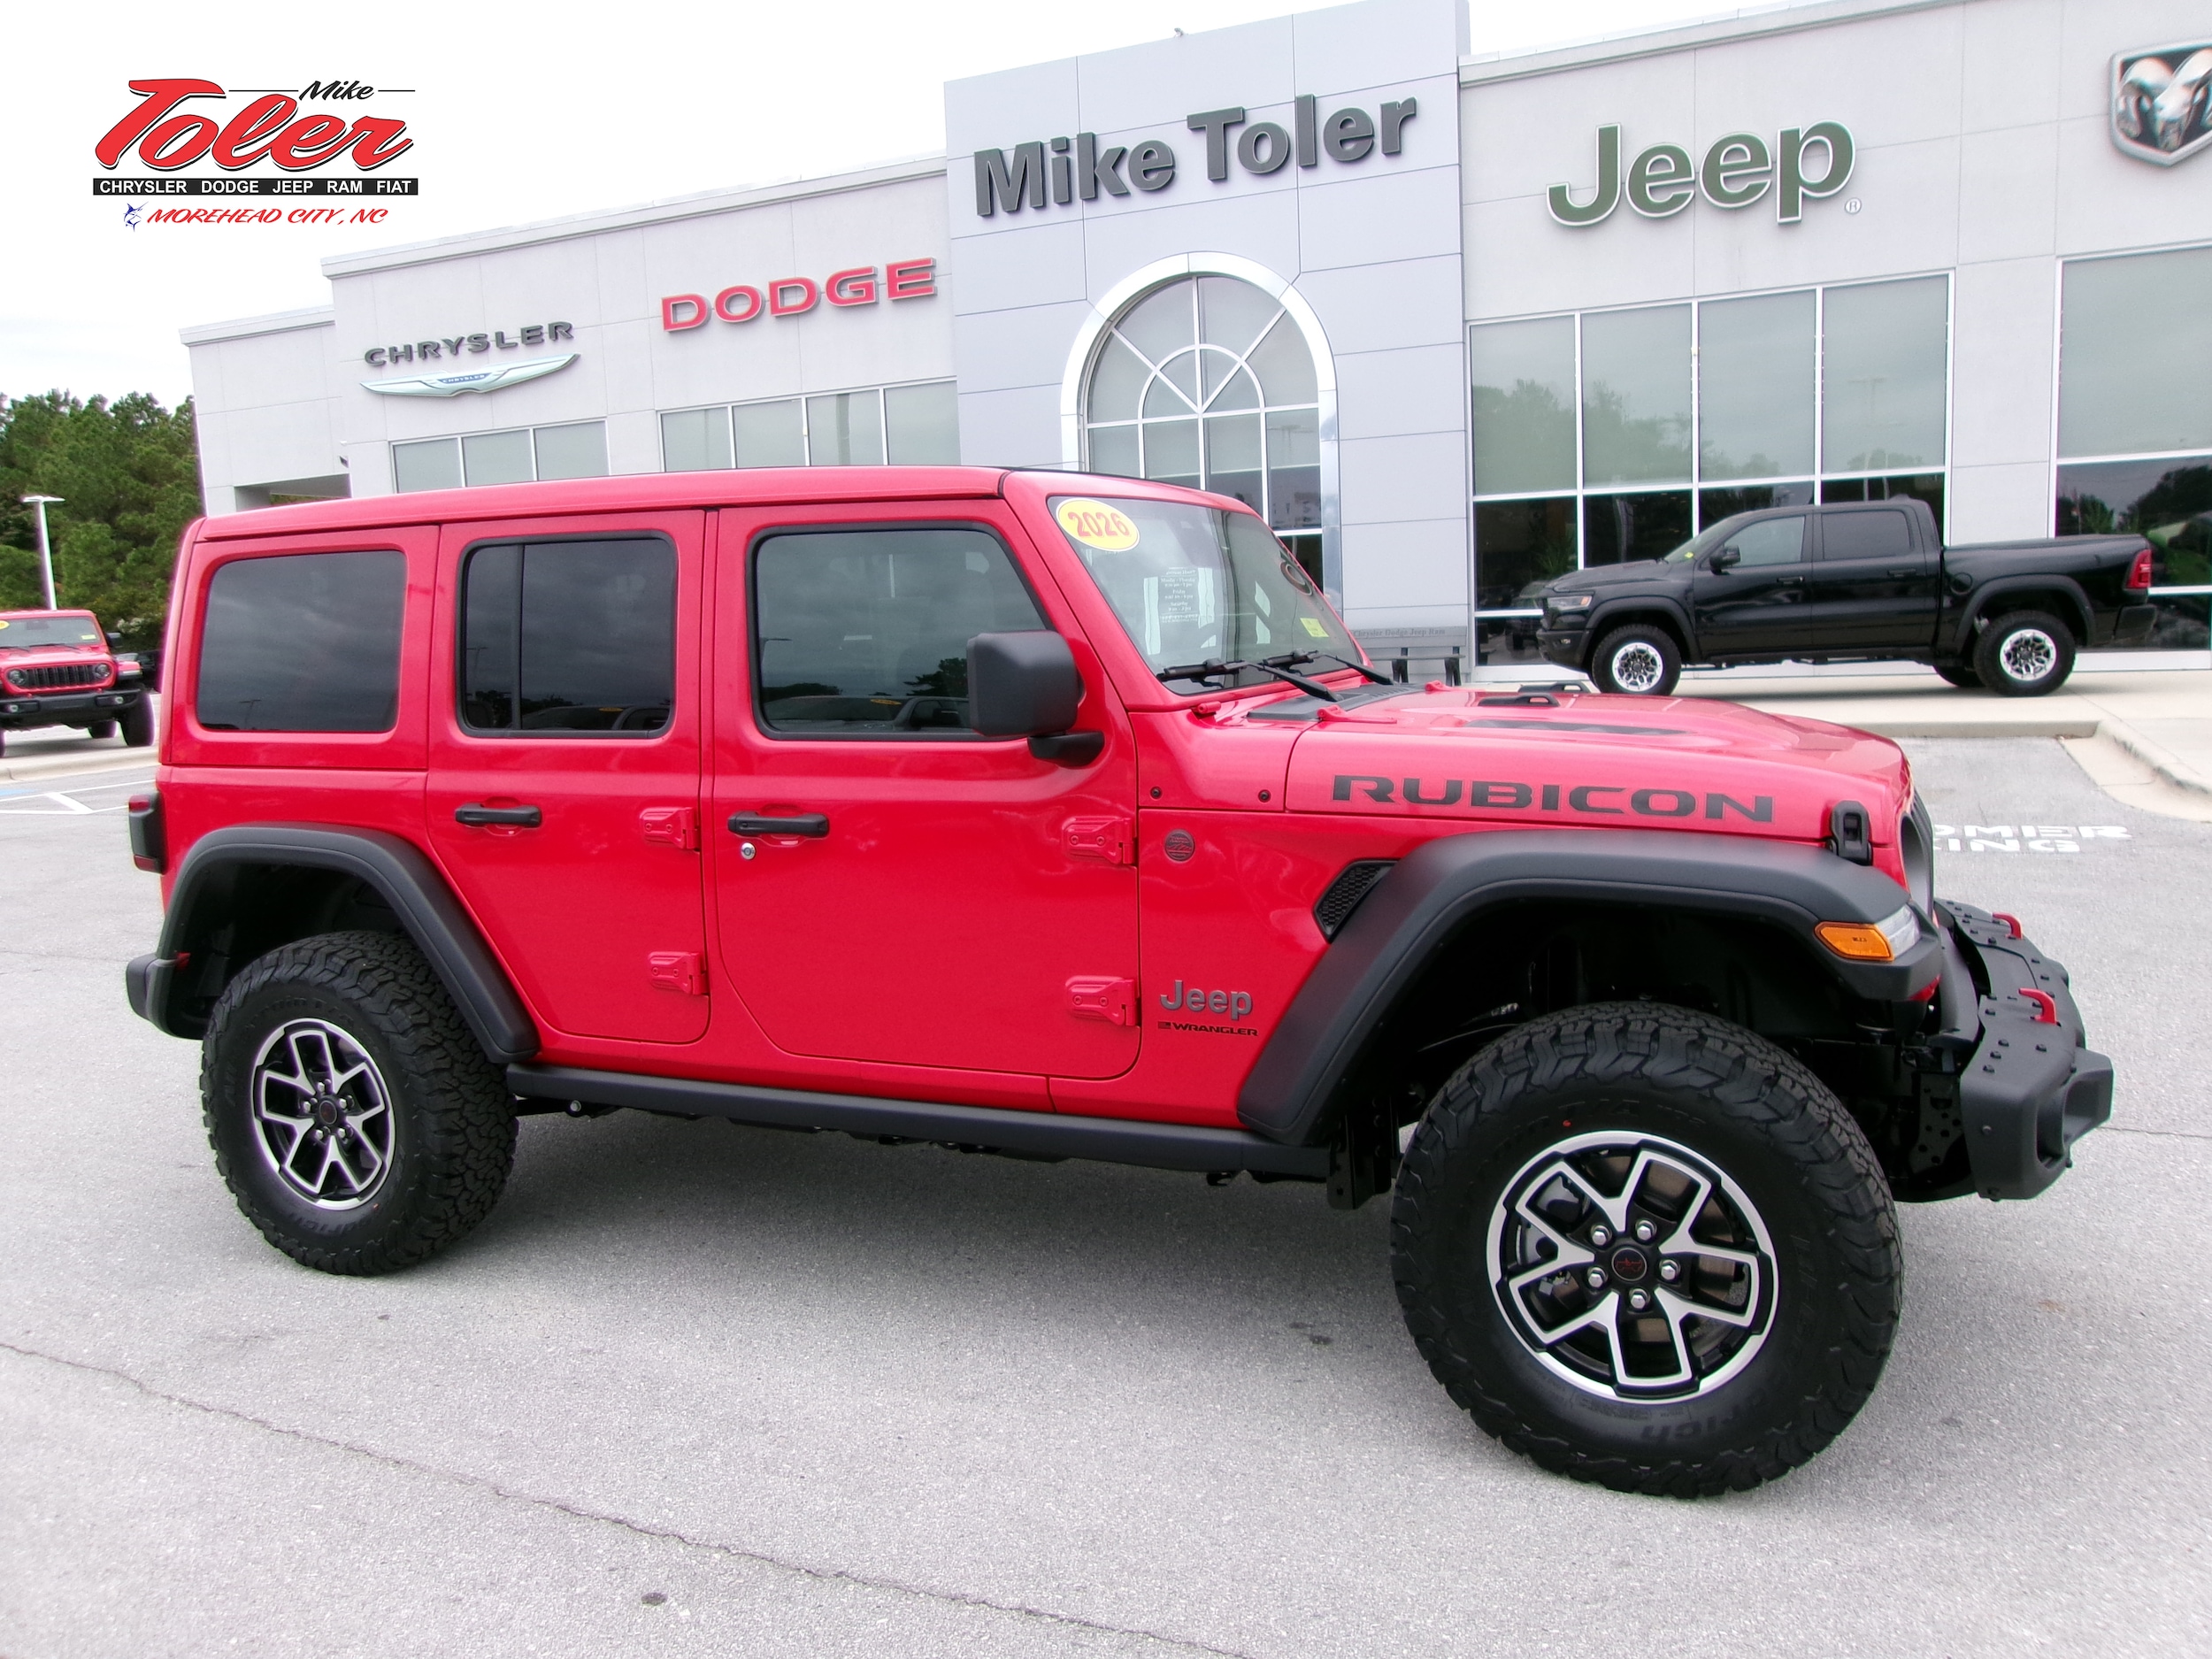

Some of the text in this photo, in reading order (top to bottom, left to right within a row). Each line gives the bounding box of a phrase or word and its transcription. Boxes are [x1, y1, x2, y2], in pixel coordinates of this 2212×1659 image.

[974, 93, 1417, 217] Mike Toler
[1546, 120, 1857, 226] Jeep
[660, 257, 939, 333] DODGE
[364, 321, 575, 366] CHRYSLER
[442, 374, 485, 383] CHRYSLER
[1067, 511, 1132, 537] 2026
[1333, 775, 1775, 822] RUBICON
[1160, 979, 1252, 1020] Jeep
[1173, 1023, 1258, 1036] WRANGLER
